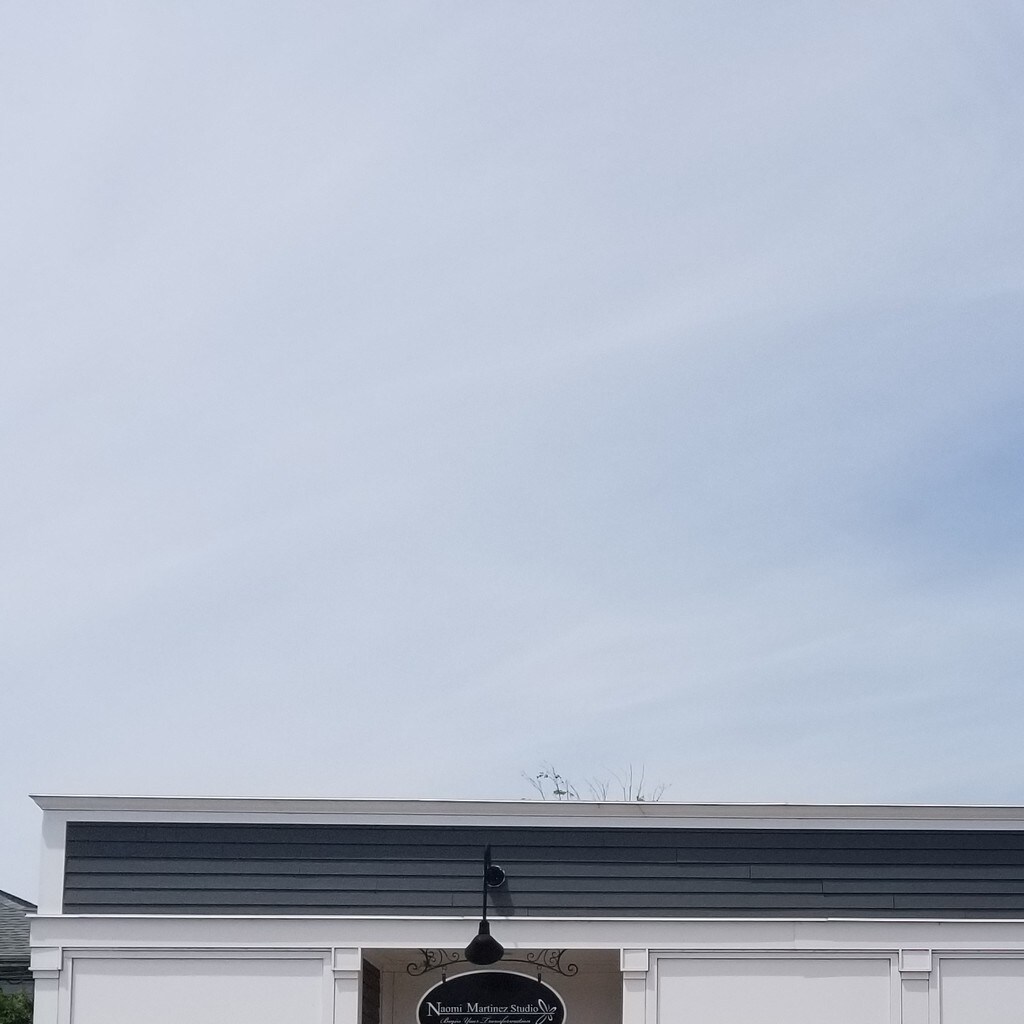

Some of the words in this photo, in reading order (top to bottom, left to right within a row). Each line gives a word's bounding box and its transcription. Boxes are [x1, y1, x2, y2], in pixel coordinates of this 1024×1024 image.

[426, 1002, 462, 1016] Naomi
[466, 1002, 508, 1013] Martinez
[510, 1004, 538, 1013] Studio
